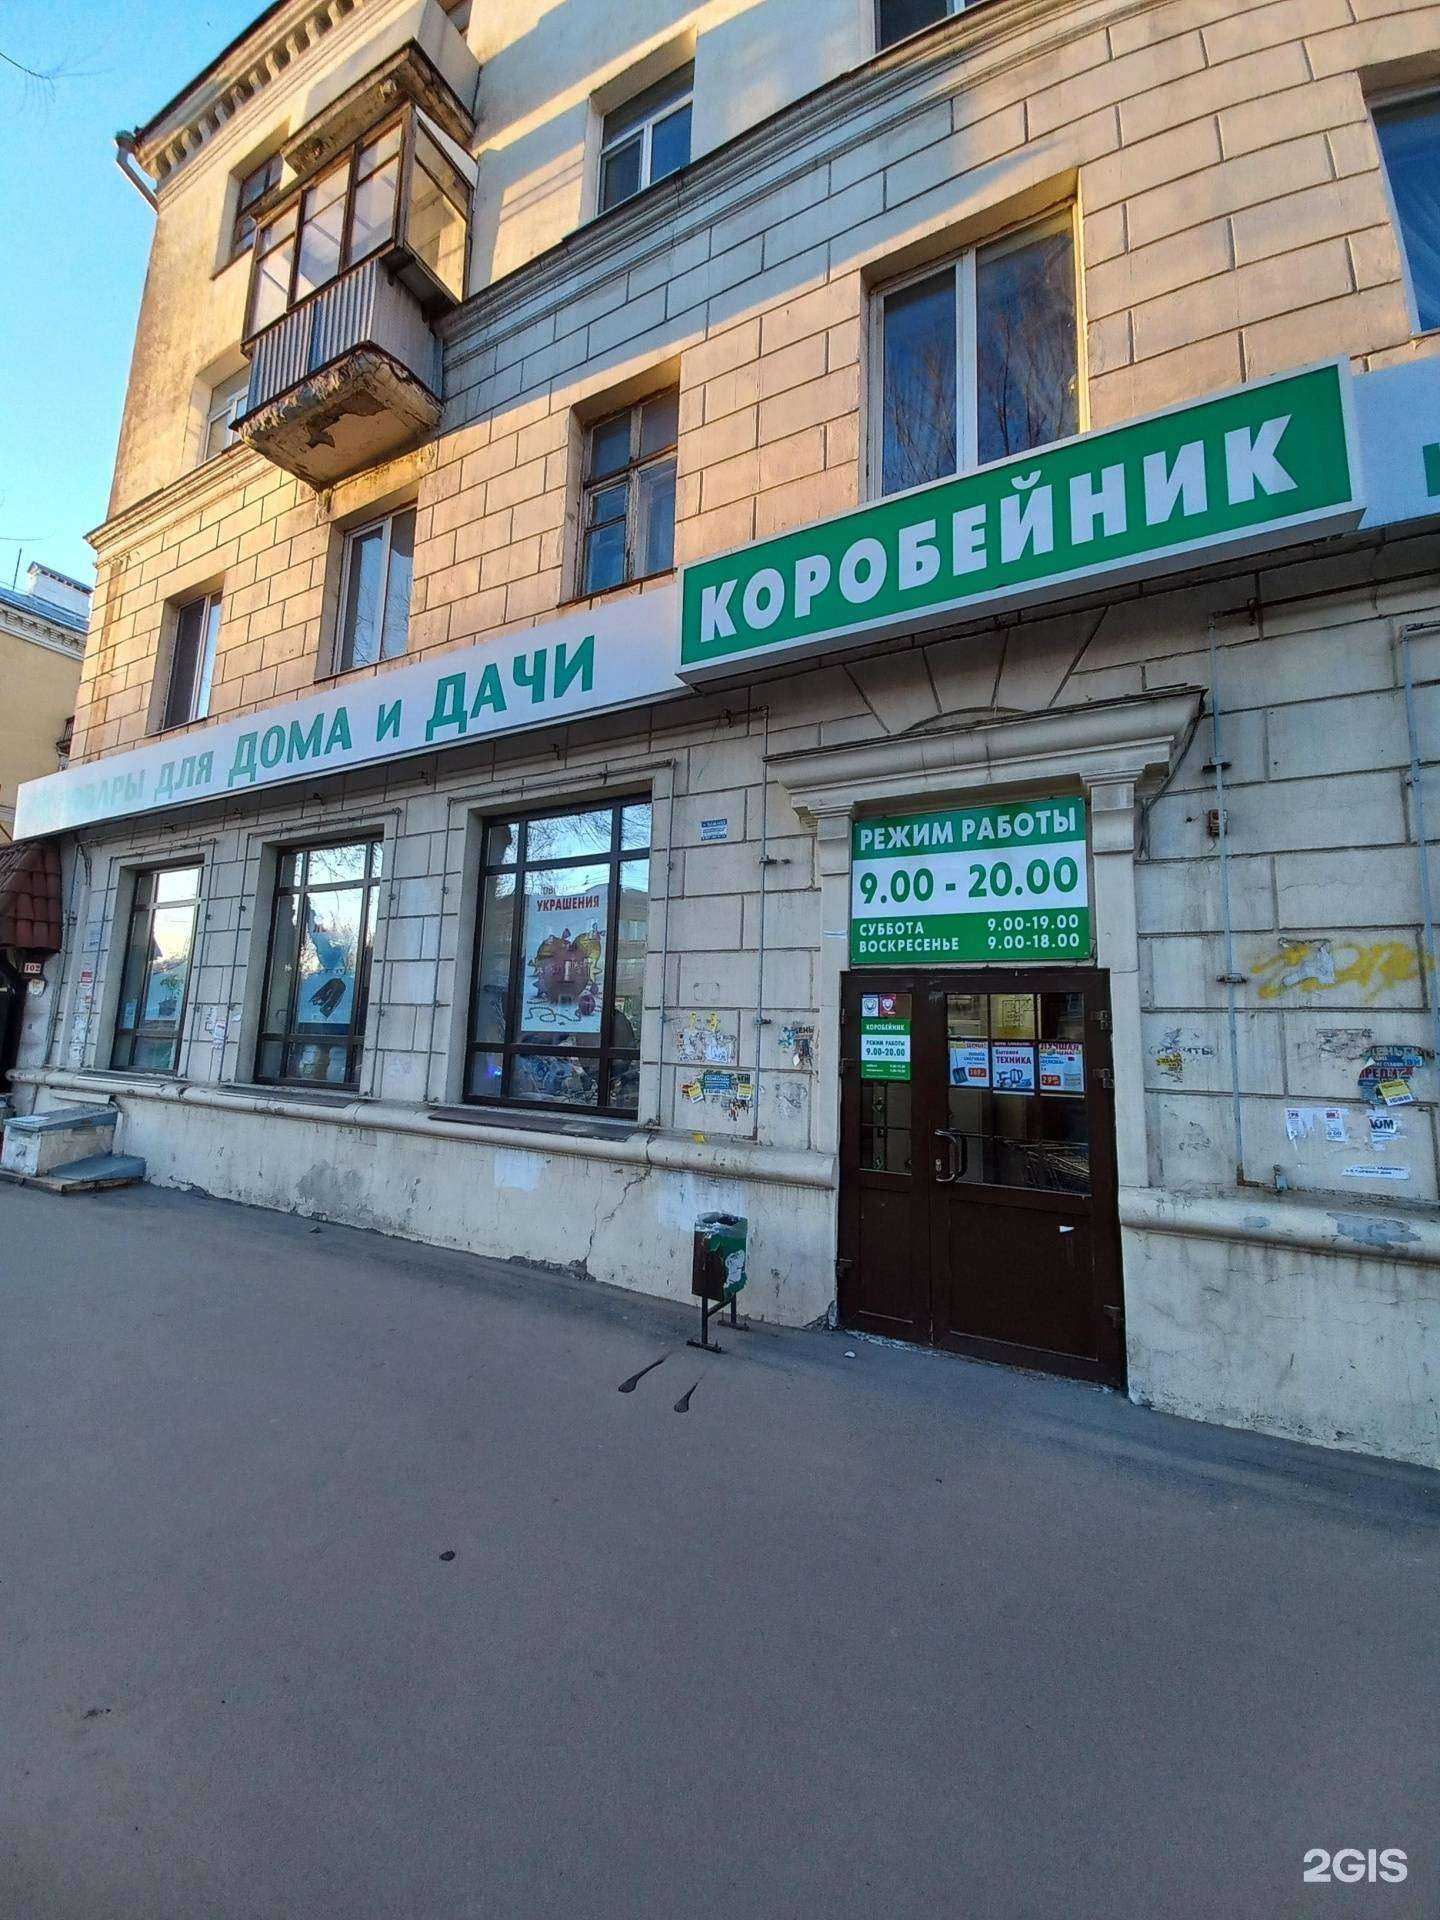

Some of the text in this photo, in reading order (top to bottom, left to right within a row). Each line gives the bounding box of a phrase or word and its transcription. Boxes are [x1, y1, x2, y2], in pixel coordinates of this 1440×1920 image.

[700, 414, 1298, 643] КОРОБЕЙНИК
[154, 750, 215, 802] ДЛЯ
[228, 706, 352, 788] ДОМА
[425, 634, 595, 742] ДАЧИ
[860, 807, 1076, 851] РЕЖИМ РАБОТЫ
[860, 868, 934, 904] 9.00
[968, 856, 1079, 898] 20.00
[536, 895, 600, 912] УКРАШЕНИЯ
[859, 914, 1079, 937] СУББОТА 9.00-19.00
[859, 933, 1080, 953] ВОСКРЕСЕНЬЕ 9.00-18.00
[866, 1022, 905, 1031] КОРОБЕЙНИК
[866, 1047, 905, 1056] 9.00-20.00
[996, 1056, 1032, 1065] ТЕХНИКА
